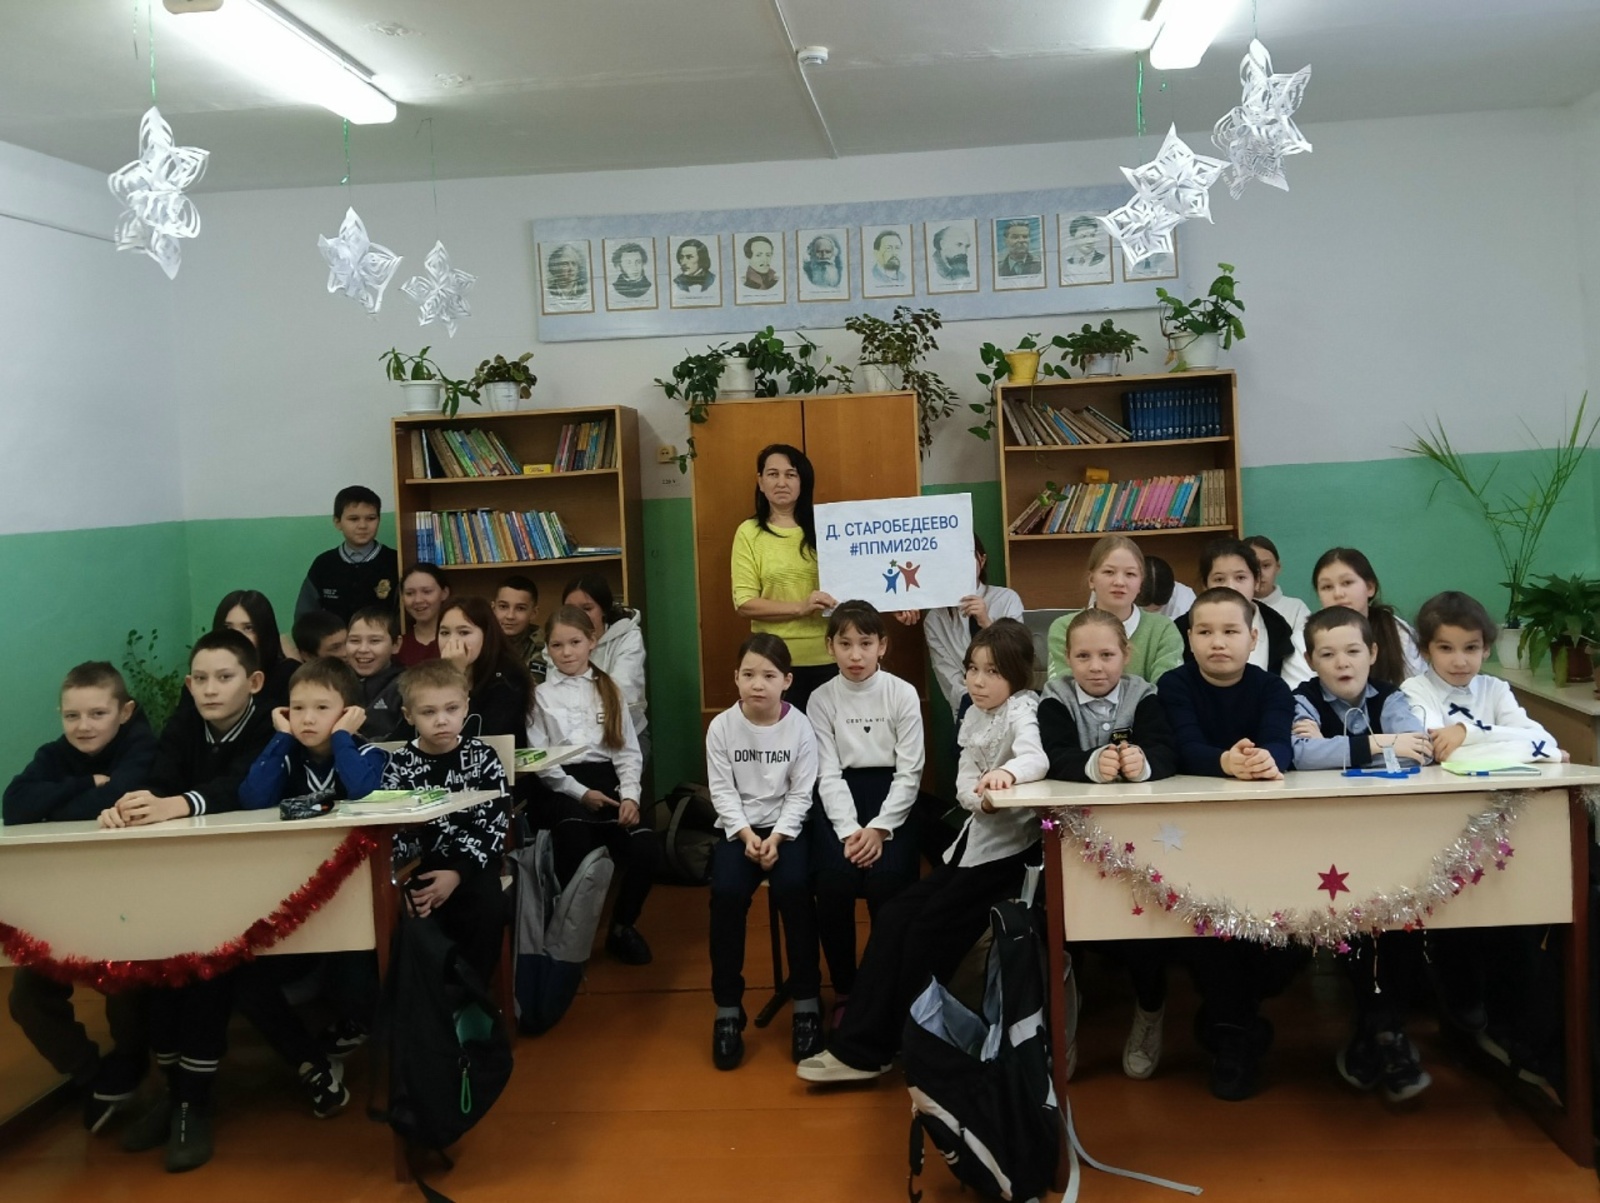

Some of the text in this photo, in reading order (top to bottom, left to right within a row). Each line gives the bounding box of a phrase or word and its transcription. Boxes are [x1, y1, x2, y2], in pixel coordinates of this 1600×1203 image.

[825, 514, 959, 540] Д. СТАРОБЕДЕЕВО
[849, 536, 938, 556] #ППМИ2026
[765, 749, 791, 764] TAGN
